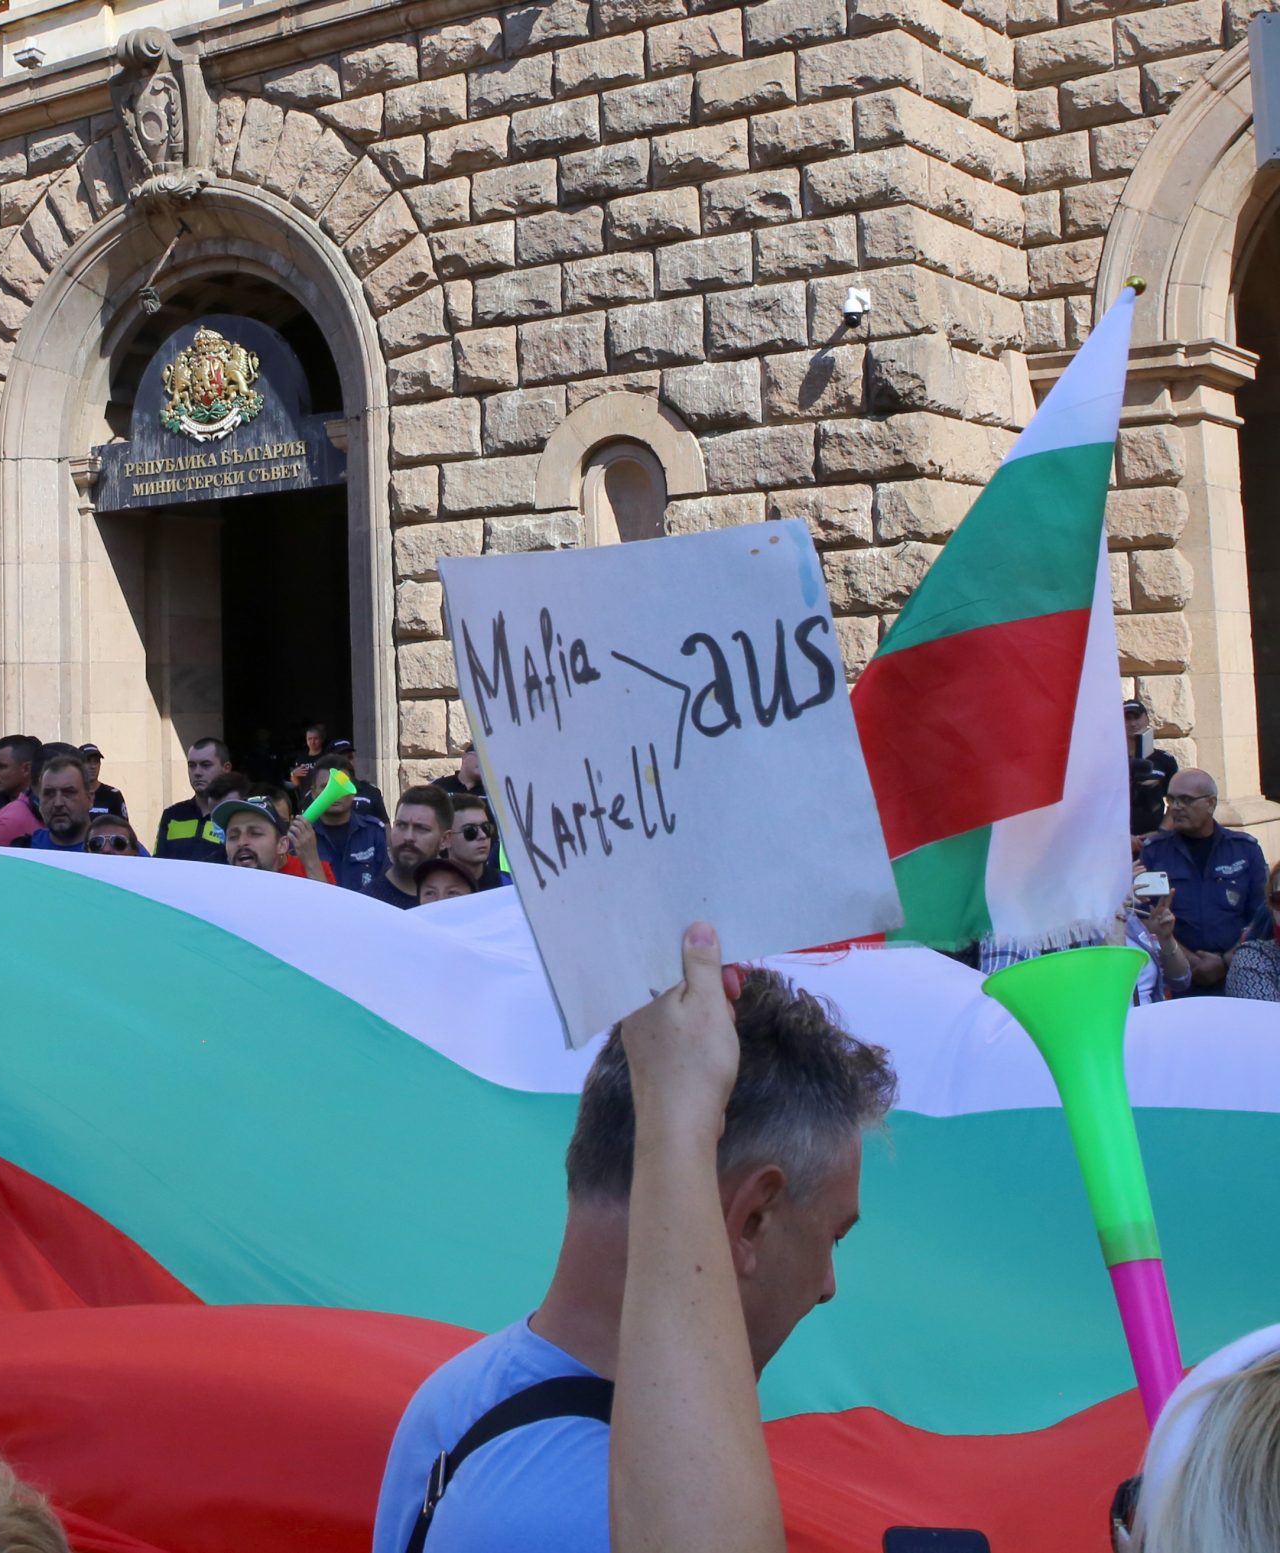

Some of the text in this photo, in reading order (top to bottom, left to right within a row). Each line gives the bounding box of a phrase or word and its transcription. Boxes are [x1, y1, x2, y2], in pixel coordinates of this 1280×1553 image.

[124, 441, 306, 478] РЕПУБЛИКА БЪЛГАРИЯ
[132, 463, 301, 497] МИНИСТЕРСКИ СЪВЕТ
[680, 615, 835, 738] aus
